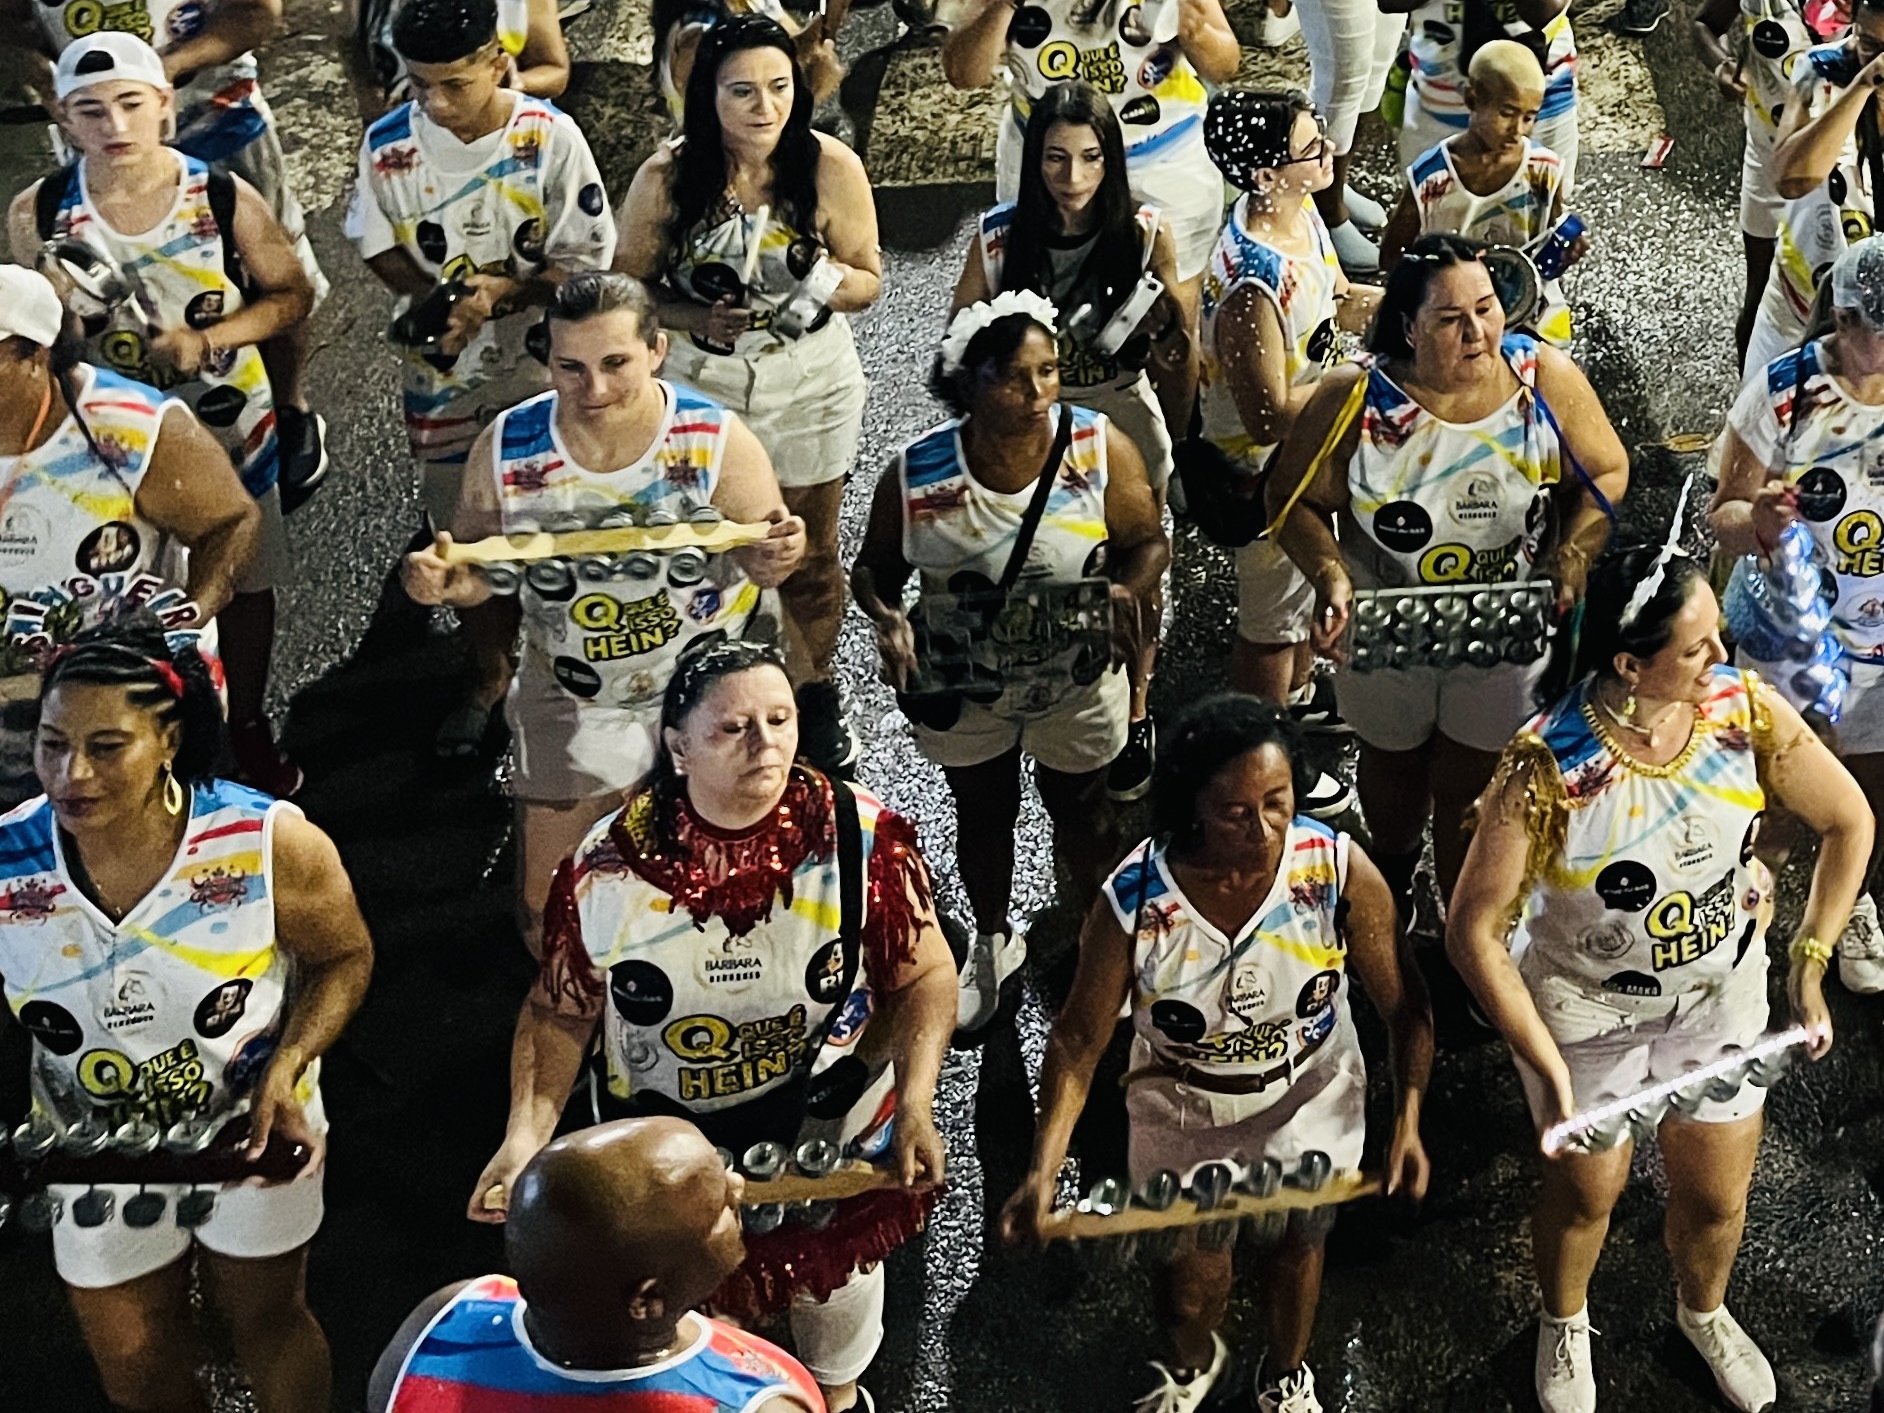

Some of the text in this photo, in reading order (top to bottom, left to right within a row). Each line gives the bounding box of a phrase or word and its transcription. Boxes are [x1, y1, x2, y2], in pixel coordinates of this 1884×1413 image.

[1037, 40, 1081, 81] Q
[1418, 541, 1478, 585] Q
[570, 592, 626, 632] Q
[626, 607, 678, 633] ISSO
[584, 619, 683, 663] HEIN?
[1645, 891, 1698, 940] Q
[705, 956, 762, 972] BARBARA
[661, 1013, 740, 1063] Q
[77, 1048, 138, 1099] Q
